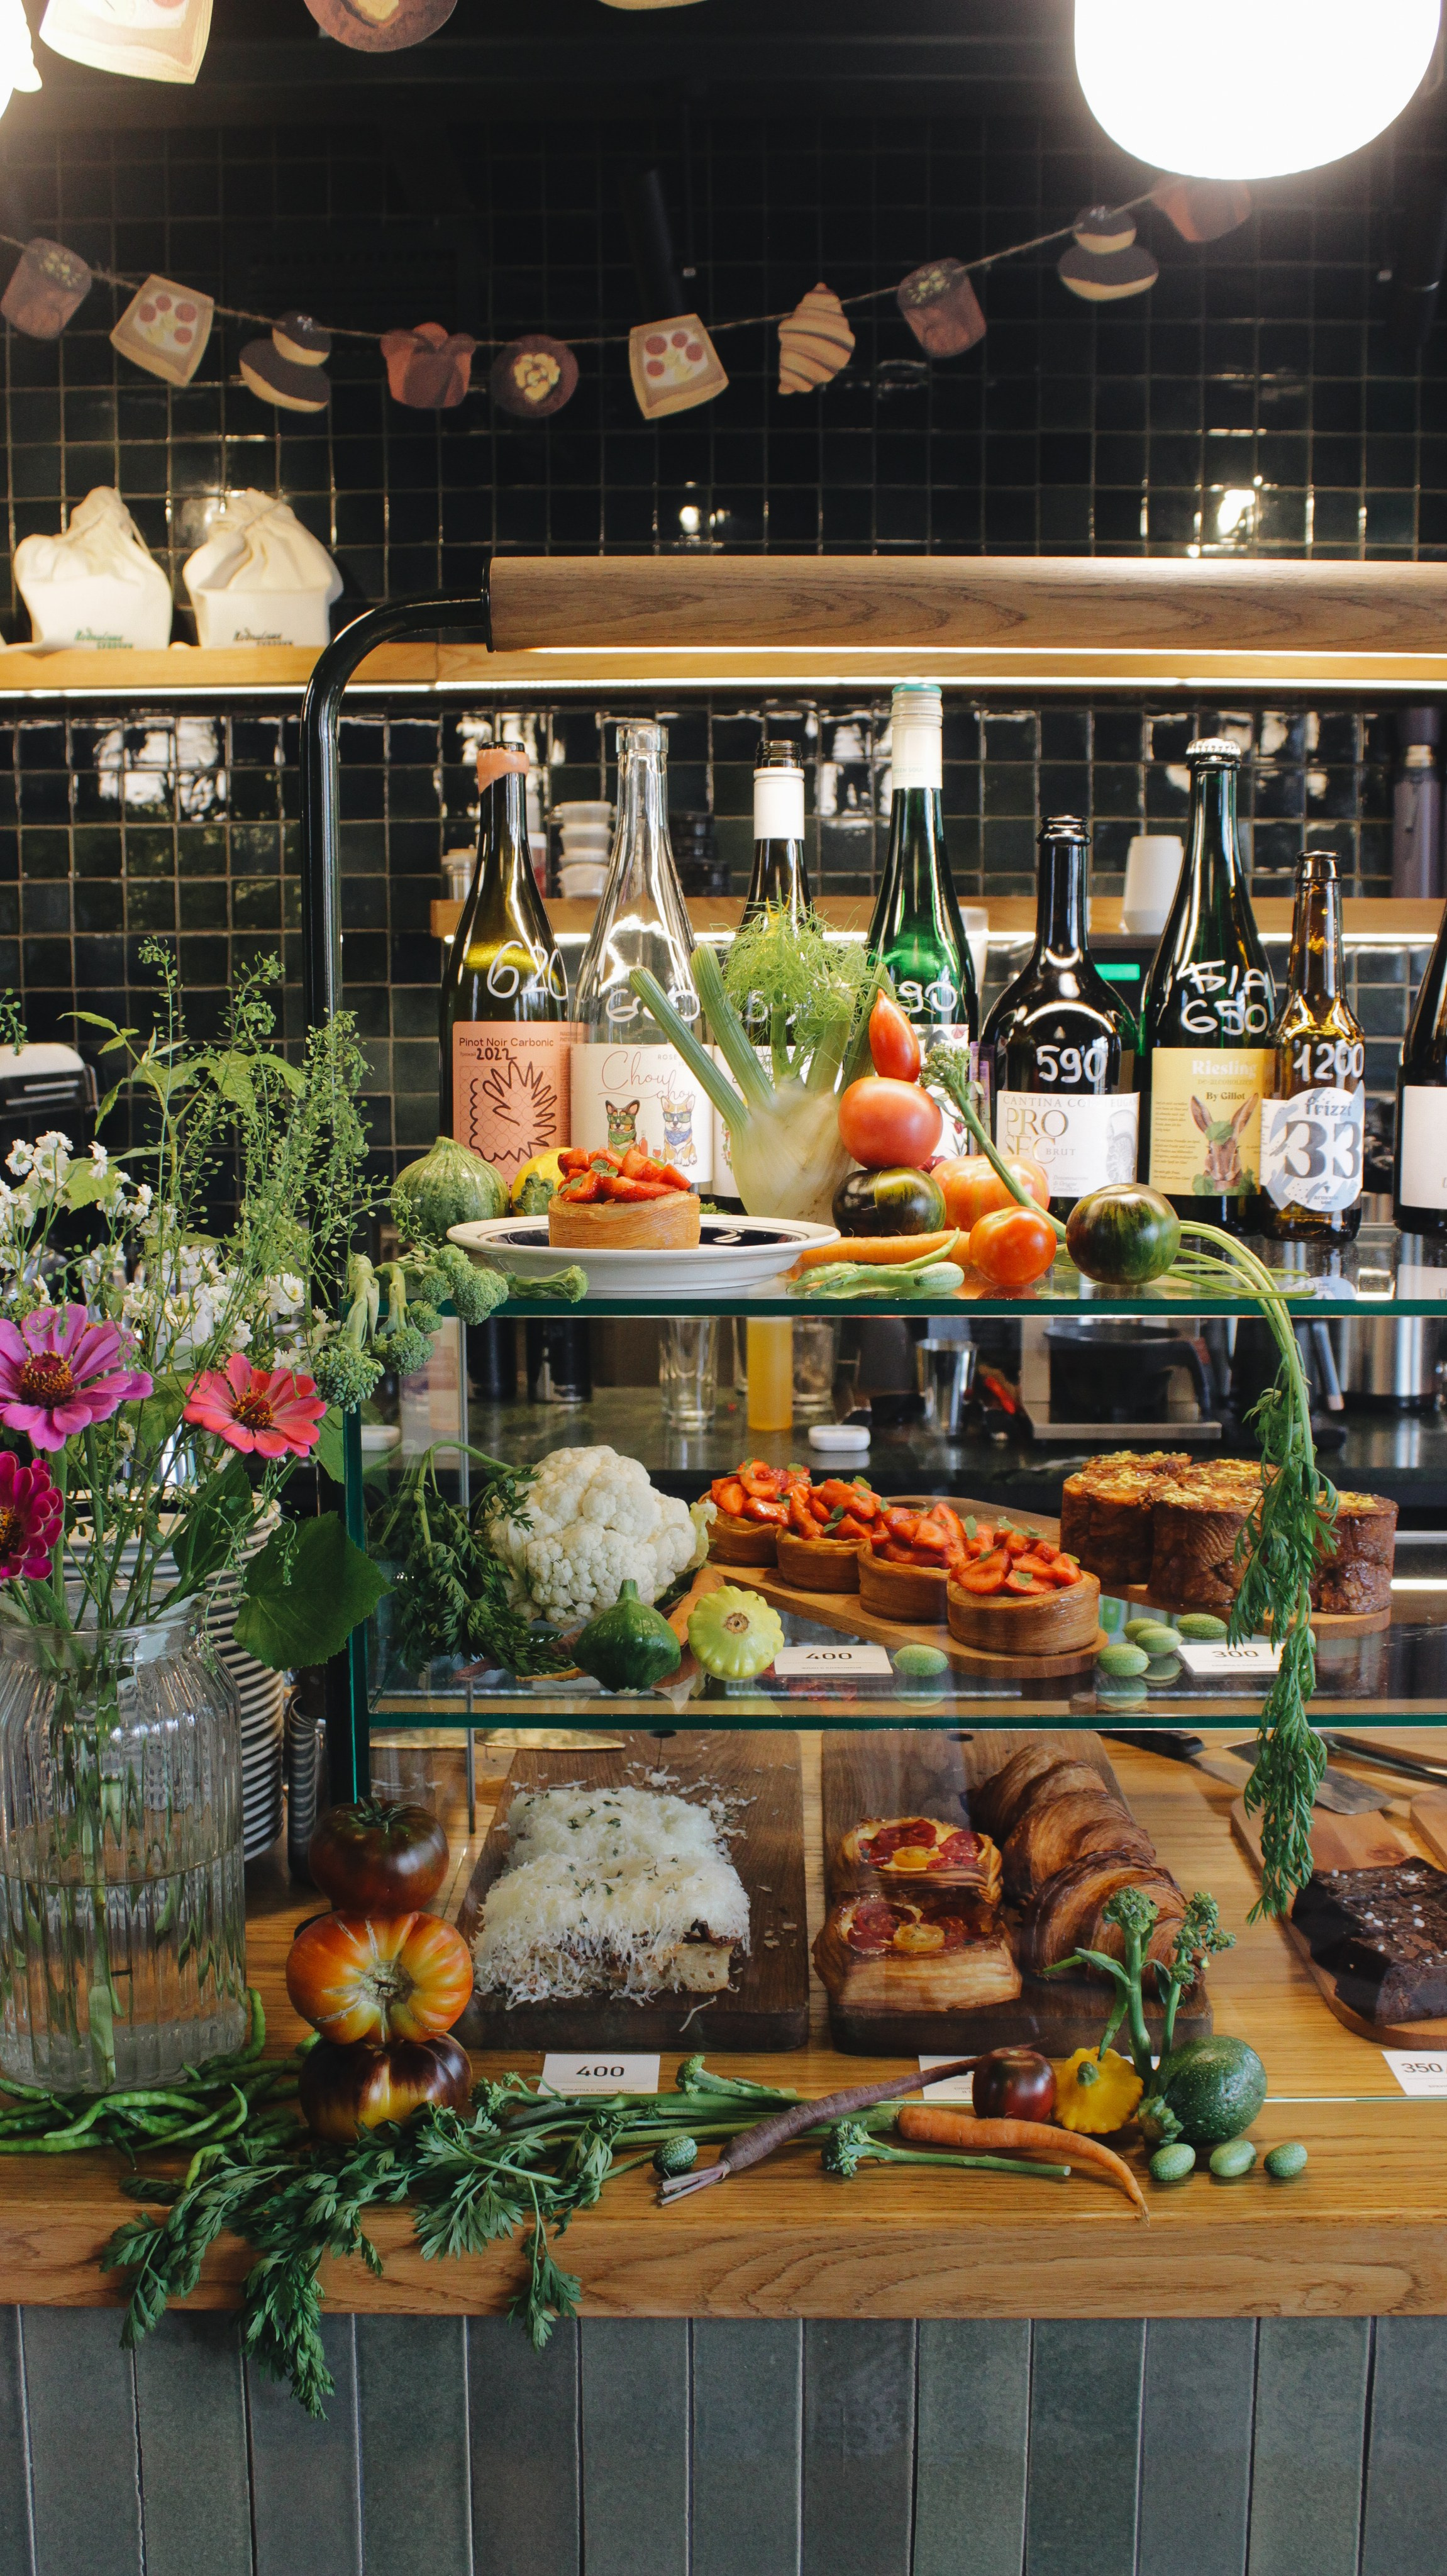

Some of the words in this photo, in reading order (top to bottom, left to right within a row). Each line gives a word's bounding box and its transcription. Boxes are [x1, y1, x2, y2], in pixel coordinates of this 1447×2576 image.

[1180, 999, 1268, 1036] 650
[459, 1038, 484, 1046] Pinot
[487, 1038, 507, 1046] Noir
[511, 1038, 554, 1046] Carbonic
[477, 1047, 518, 1061] 2022
[1293, 1043, 1364, 1082] 1200
[602, 1050, 670, 1090] Chou
[1036, 1045, 1107, 1083] 590
[1192, 1060, 1257, 1078] Riesling
[1003, 1096, 1062, 1108] CANTINA
[1206, 1092, 1219, 1101] By
[1221, 1092, 1246, 1100] Gillot
[1007, 1108, 1069, 1137] PRO
[1284, 1120, 1361, 1179] 33
[576, 2066, 625, 2077] 400
[1400, 2063, 1443, 2073] 350
